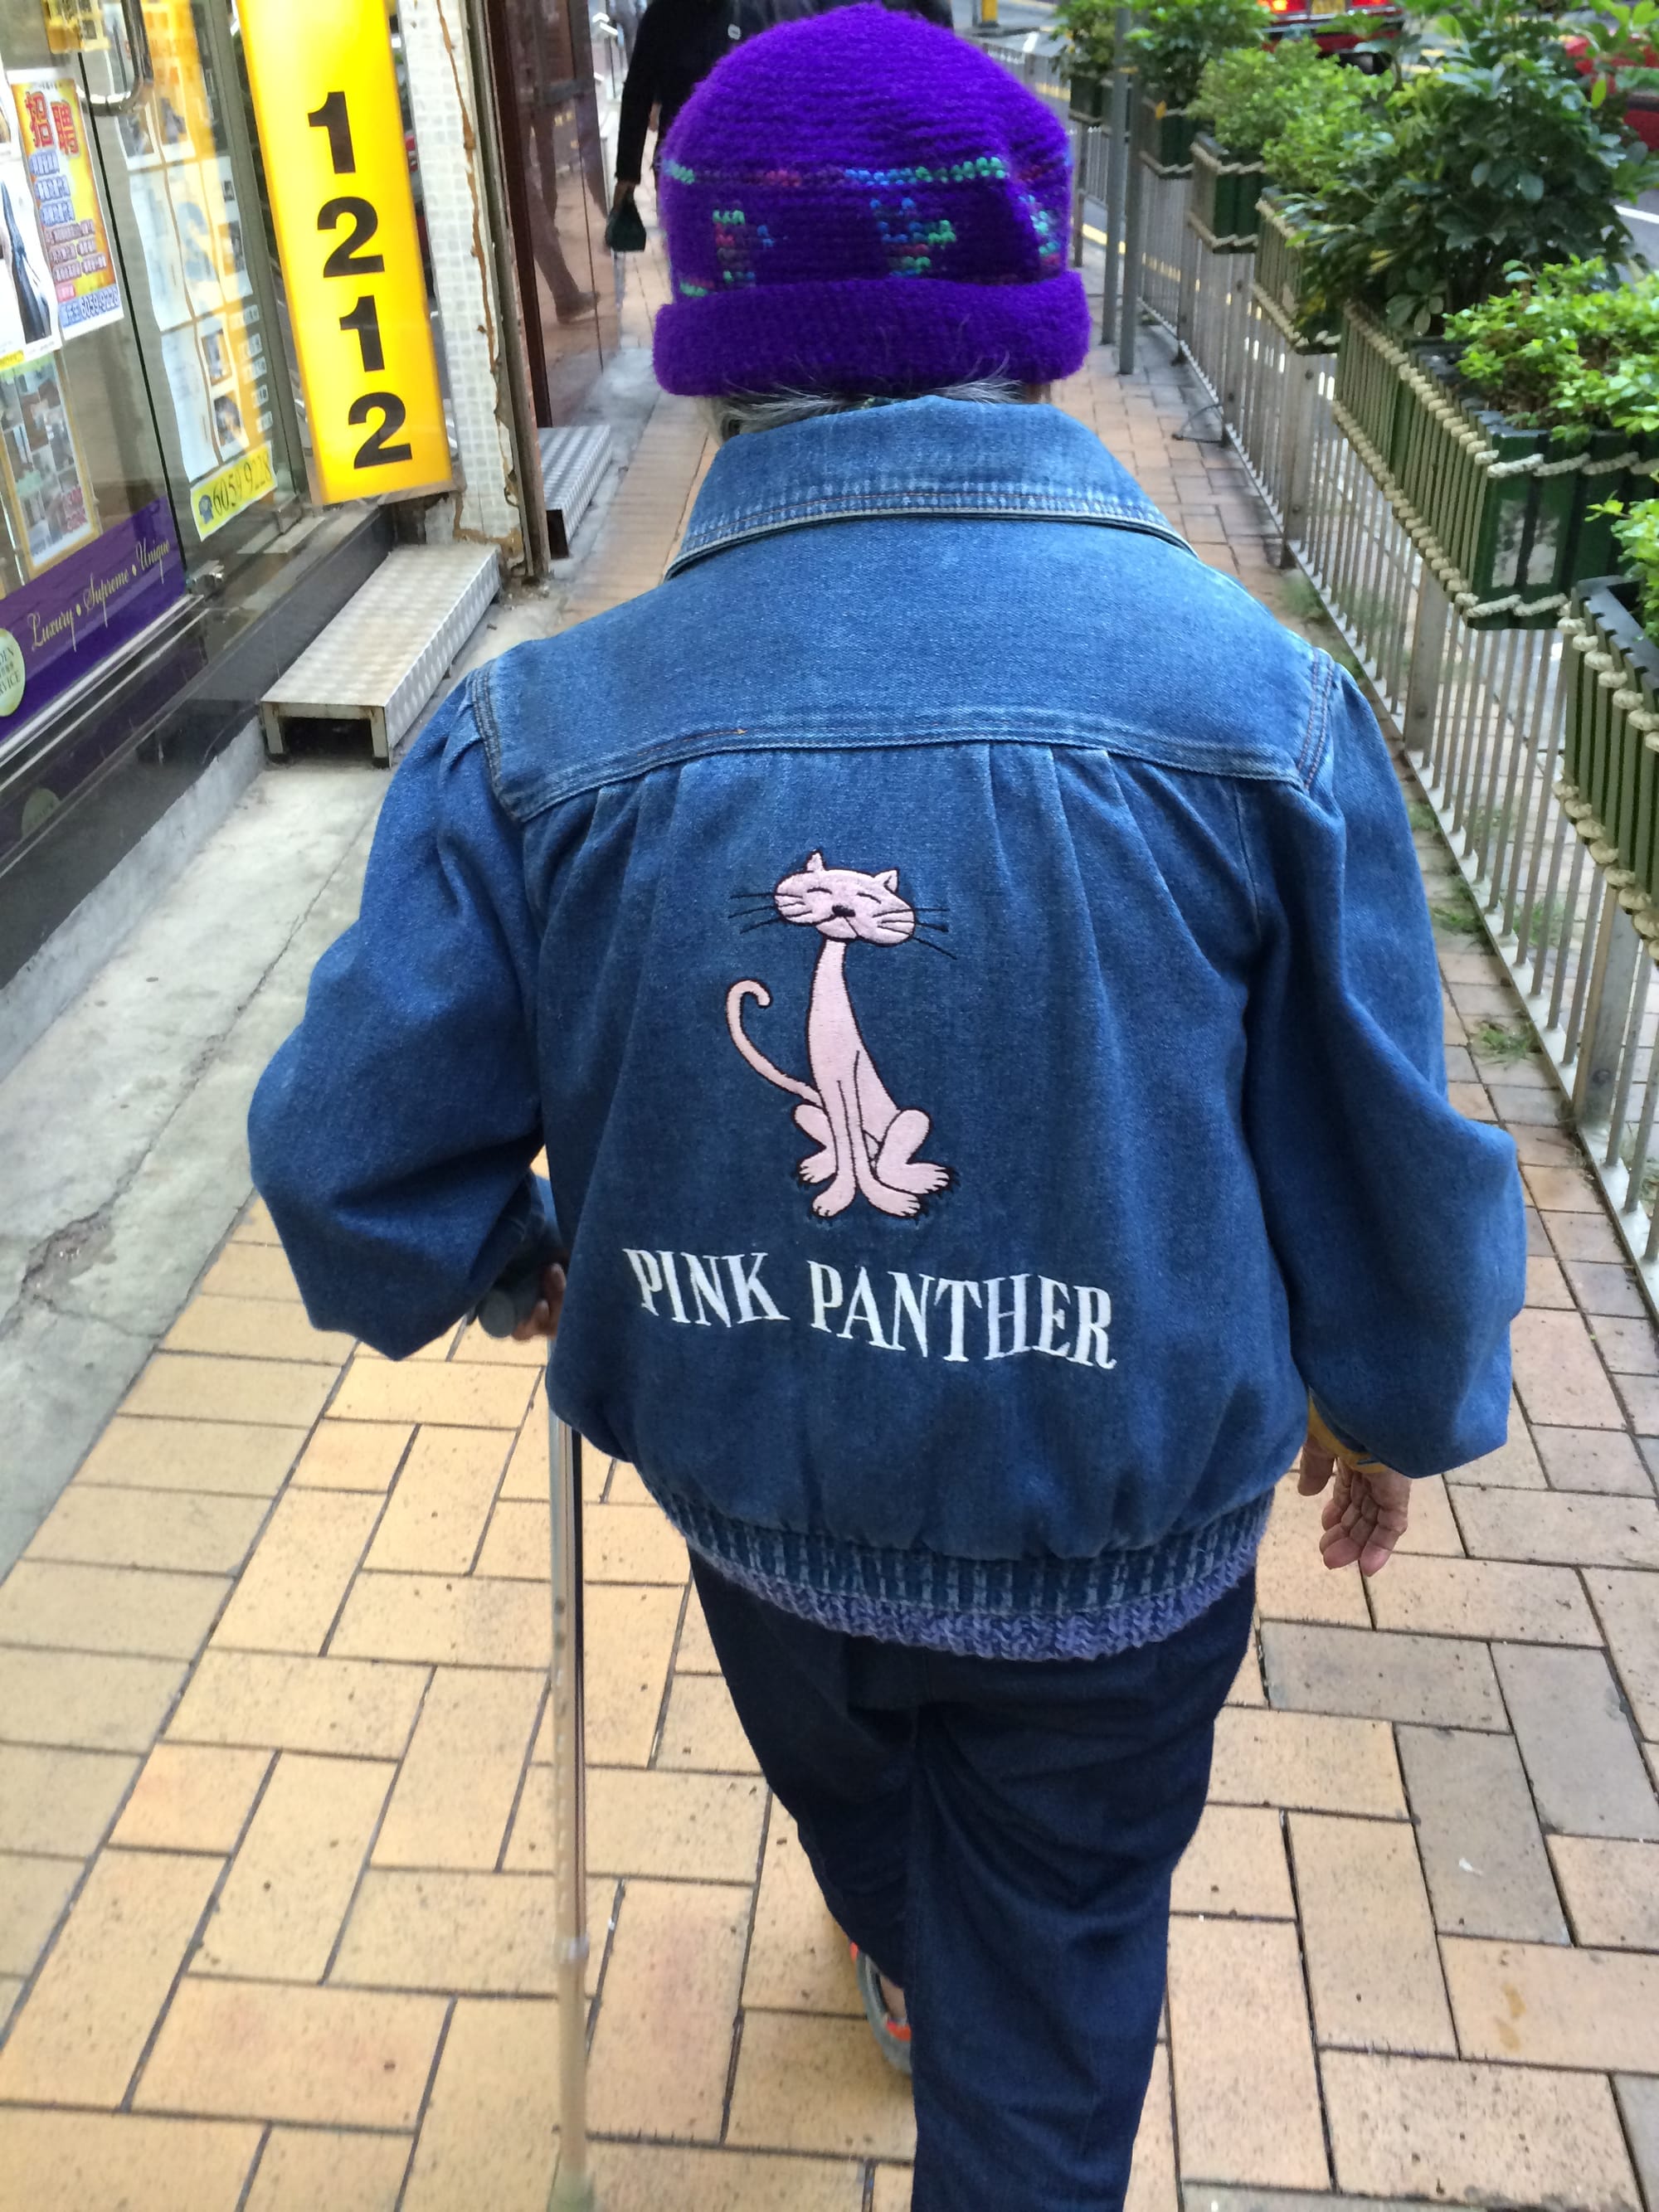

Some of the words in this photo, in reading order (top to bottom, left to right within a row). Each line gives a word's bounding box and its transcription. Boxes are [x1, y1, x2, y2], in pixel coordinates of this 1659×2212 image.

[25, 90, 80, 156] 招聘
[27, 612, 77, 653] Luxury
[83, 572, 129, 628] Supreme
[135, 537, 171, 584] Unique
[622, 1248, 791, 1328] PINK
[807, 1260, 1117, 1369] PANTHER
